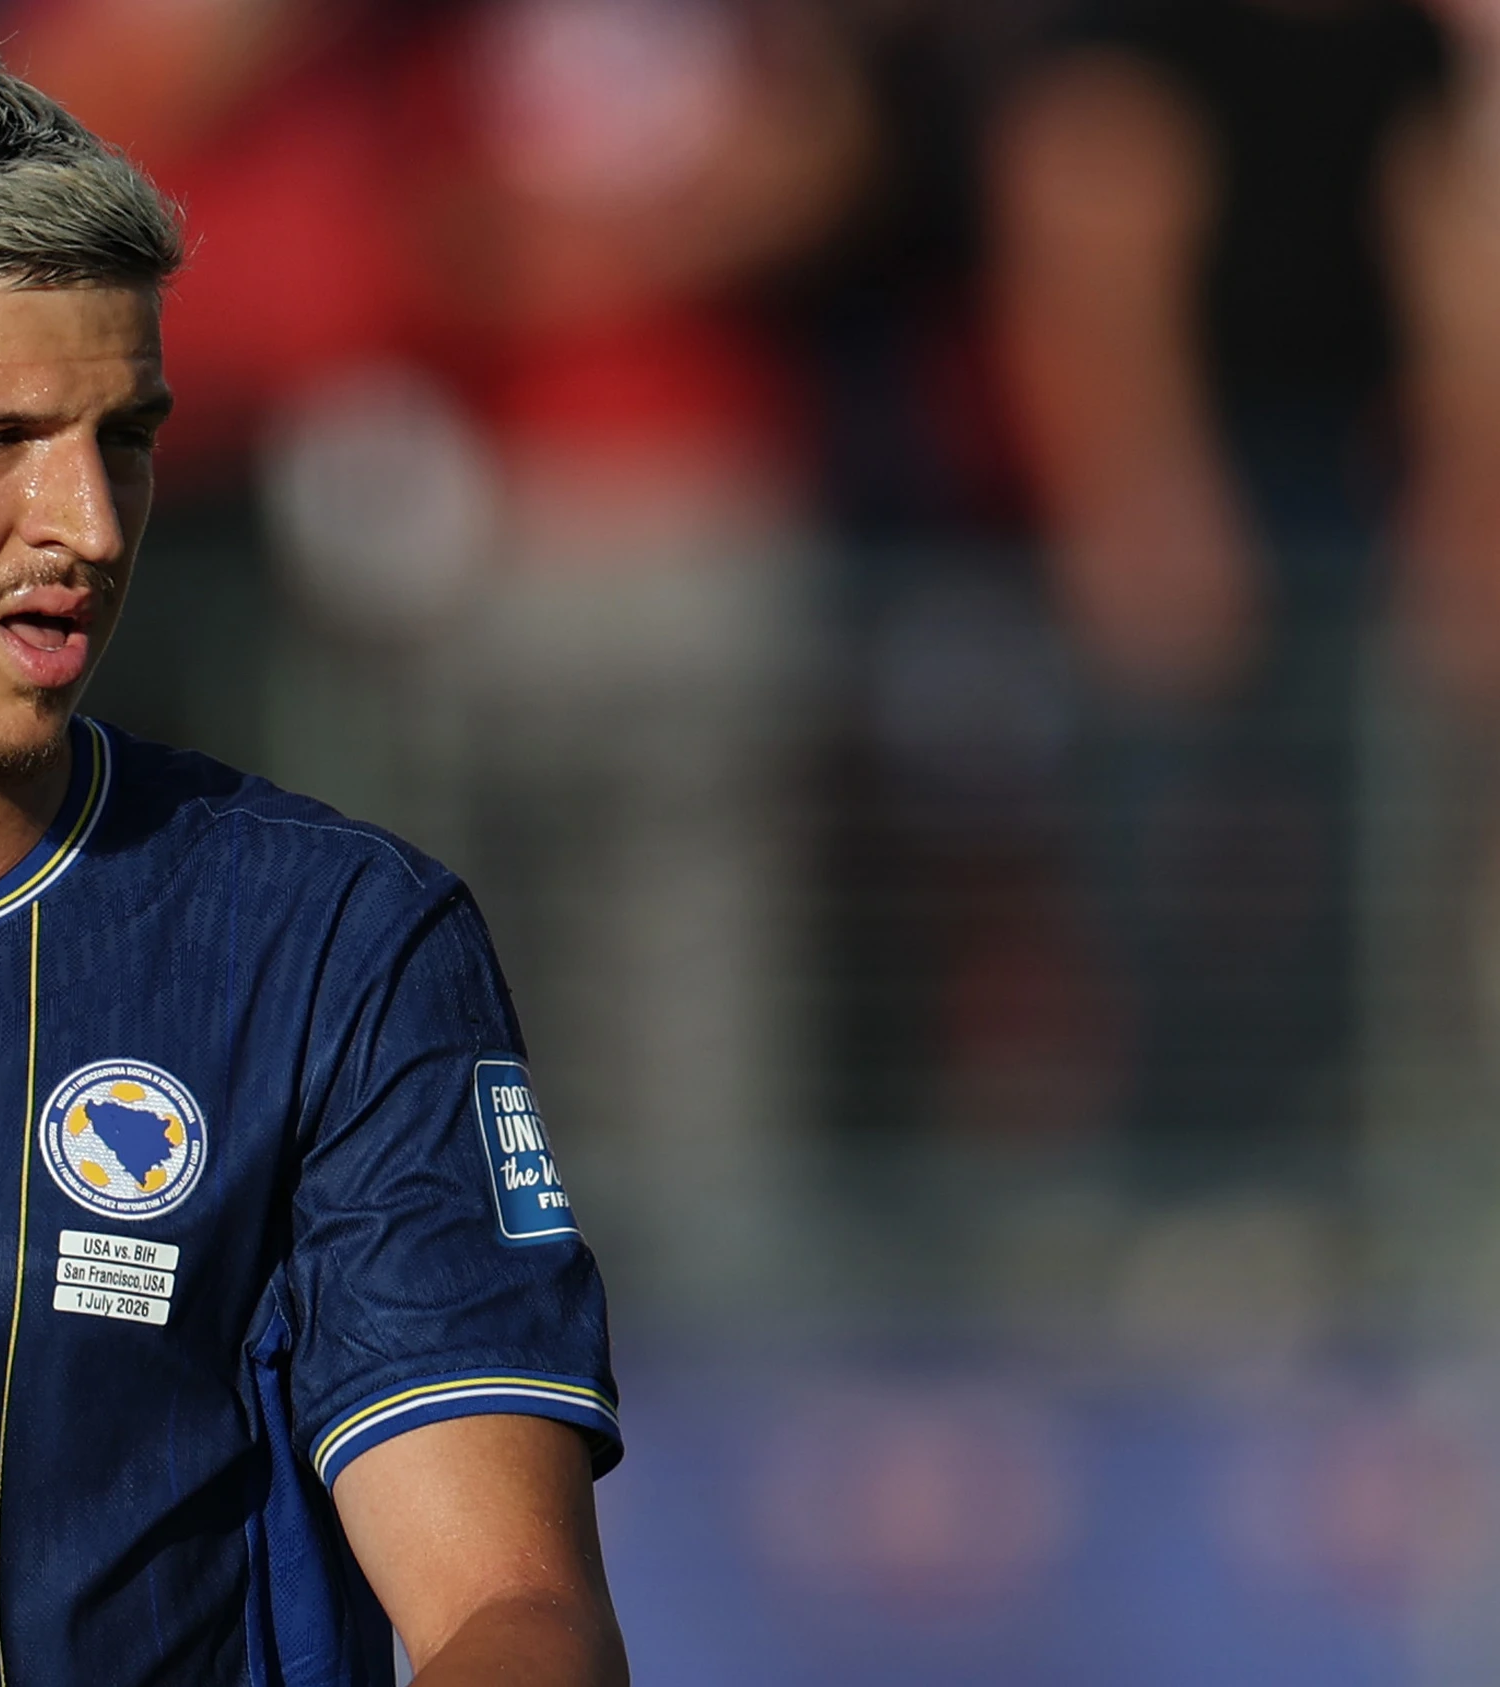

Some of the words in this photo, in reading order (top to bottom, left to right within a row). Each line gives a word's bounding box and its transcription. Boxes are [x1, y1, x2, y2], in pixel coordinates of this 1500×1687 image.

[491, 1085, 537, 1113] FOOT
[500, 1156, 540, 1190] the
[83, 1238, 111, 1256] USA
[114, 1245, 132, 1260] vs.
[133, 1245, 157, 1263] BIH
[63, 1262, 85, 1280] San
[76, 1291, 83, 1308] 1
[85, 1292, 113, 1316] July
[116, 1297, 150, 1317] 2026
